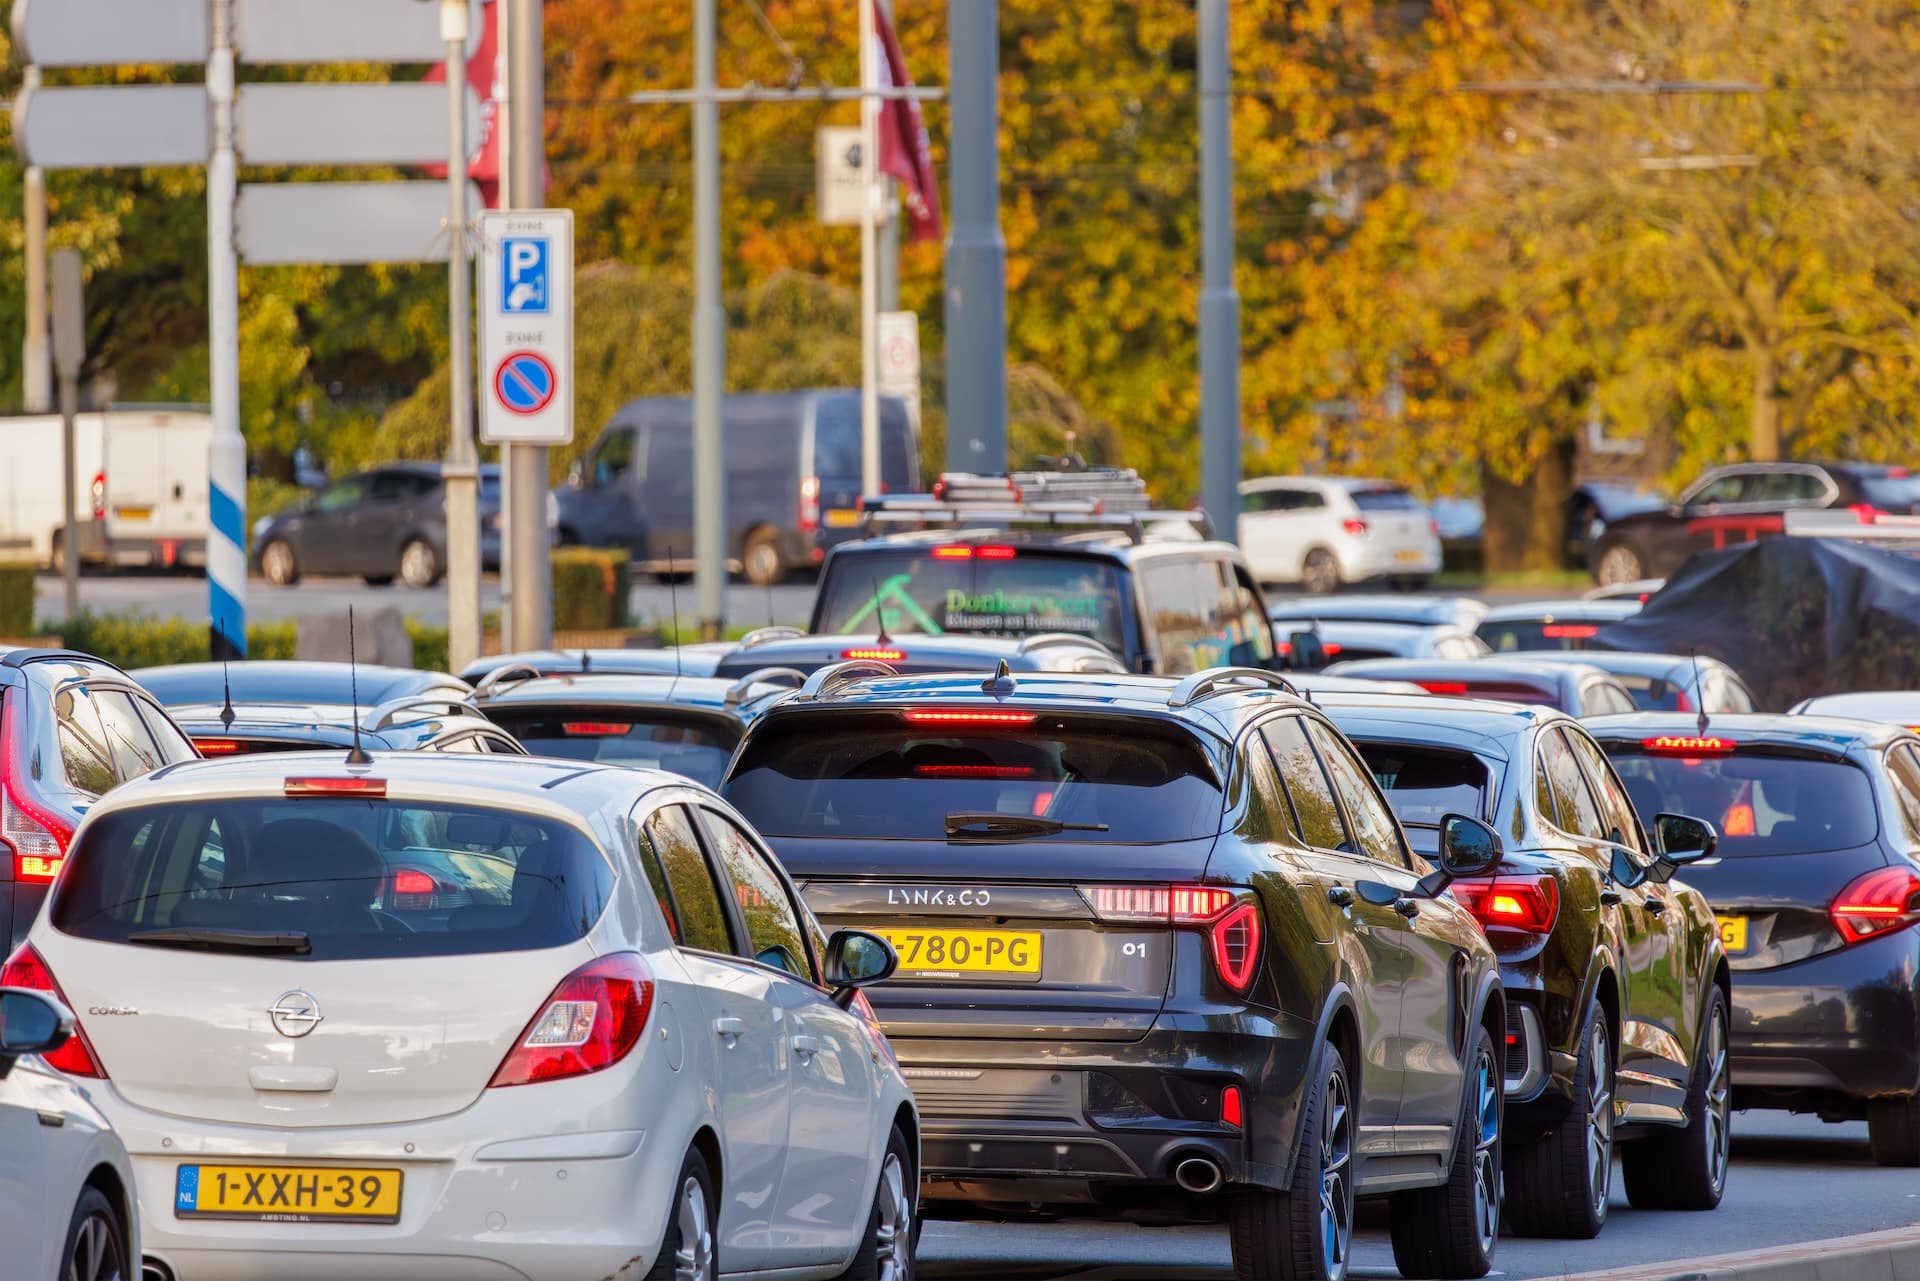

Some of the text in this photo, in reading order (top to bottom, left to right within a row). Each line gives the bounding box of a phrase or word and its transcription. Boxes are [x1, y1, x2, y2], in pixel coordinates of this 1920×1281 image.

[509, 241, 541, 284] P
[886, 934, 1028, 967] -780-PG
[179, 1192, 195, 1203] NL
[216, 1172, 382, 1209] 1-XXH-39
